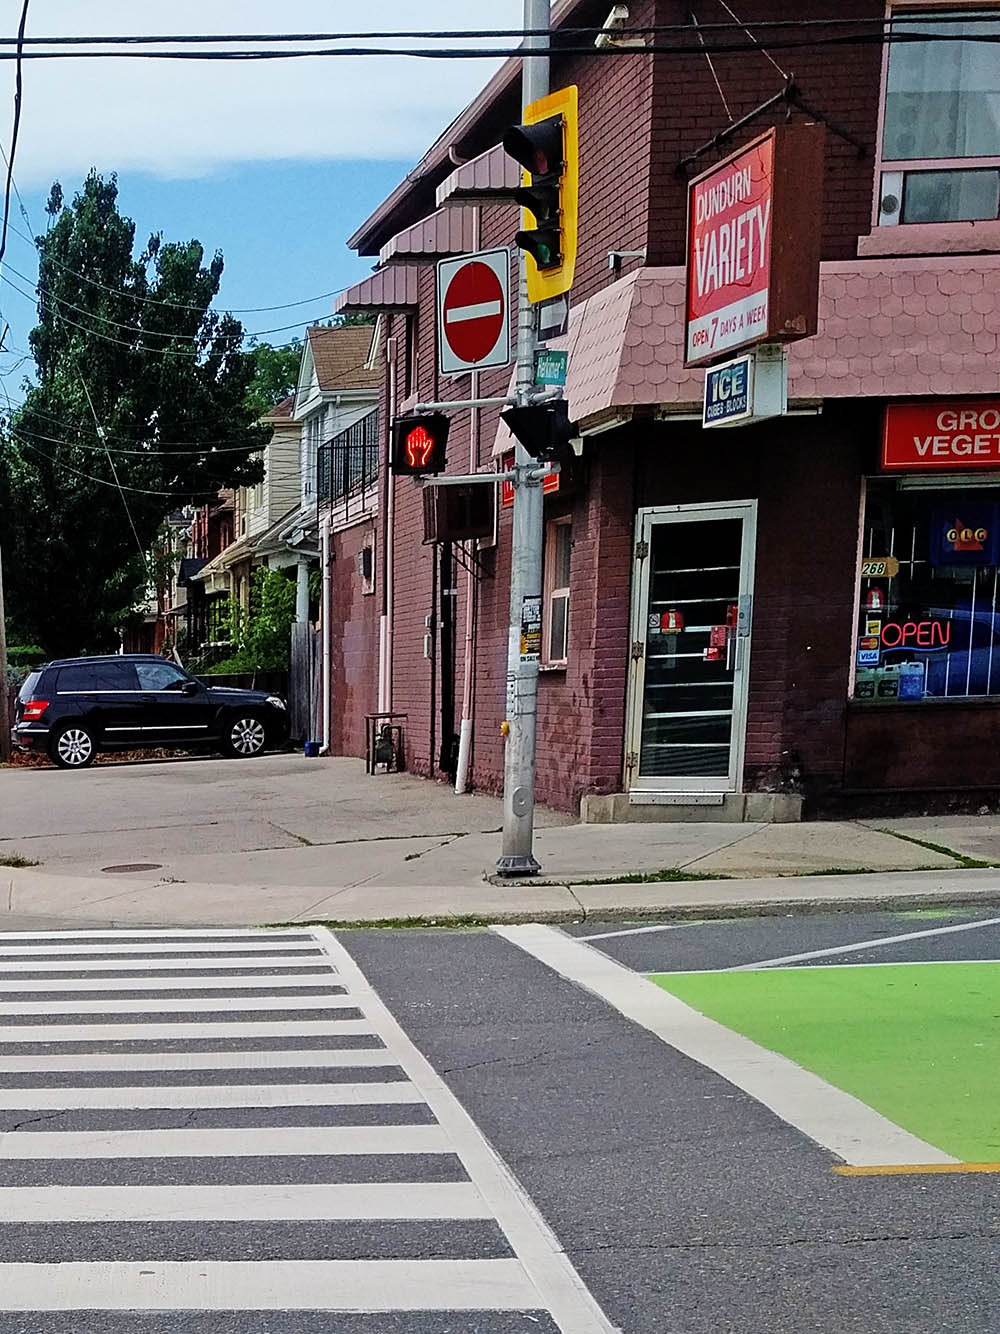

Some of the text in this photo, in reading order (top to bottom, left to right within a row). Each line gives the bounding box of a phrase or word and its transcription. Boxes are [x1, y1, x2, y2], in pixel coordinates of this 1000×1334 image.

[696, 165, 752, 225] DUNDURN
[696, 199, 771, 297] VARIETY
[692, 303, 767, 349] OPEN 7 DAYS A WEEK
[536, 356, 561, 379] Herkimer
[711, 364, 745, 403] ICE
[936, 409, 1000, 431] GRO
[946, 528, 987, 542] OLG
[863, 563, 885, 575] 268
[881, 621, 951, 647] OPEN
